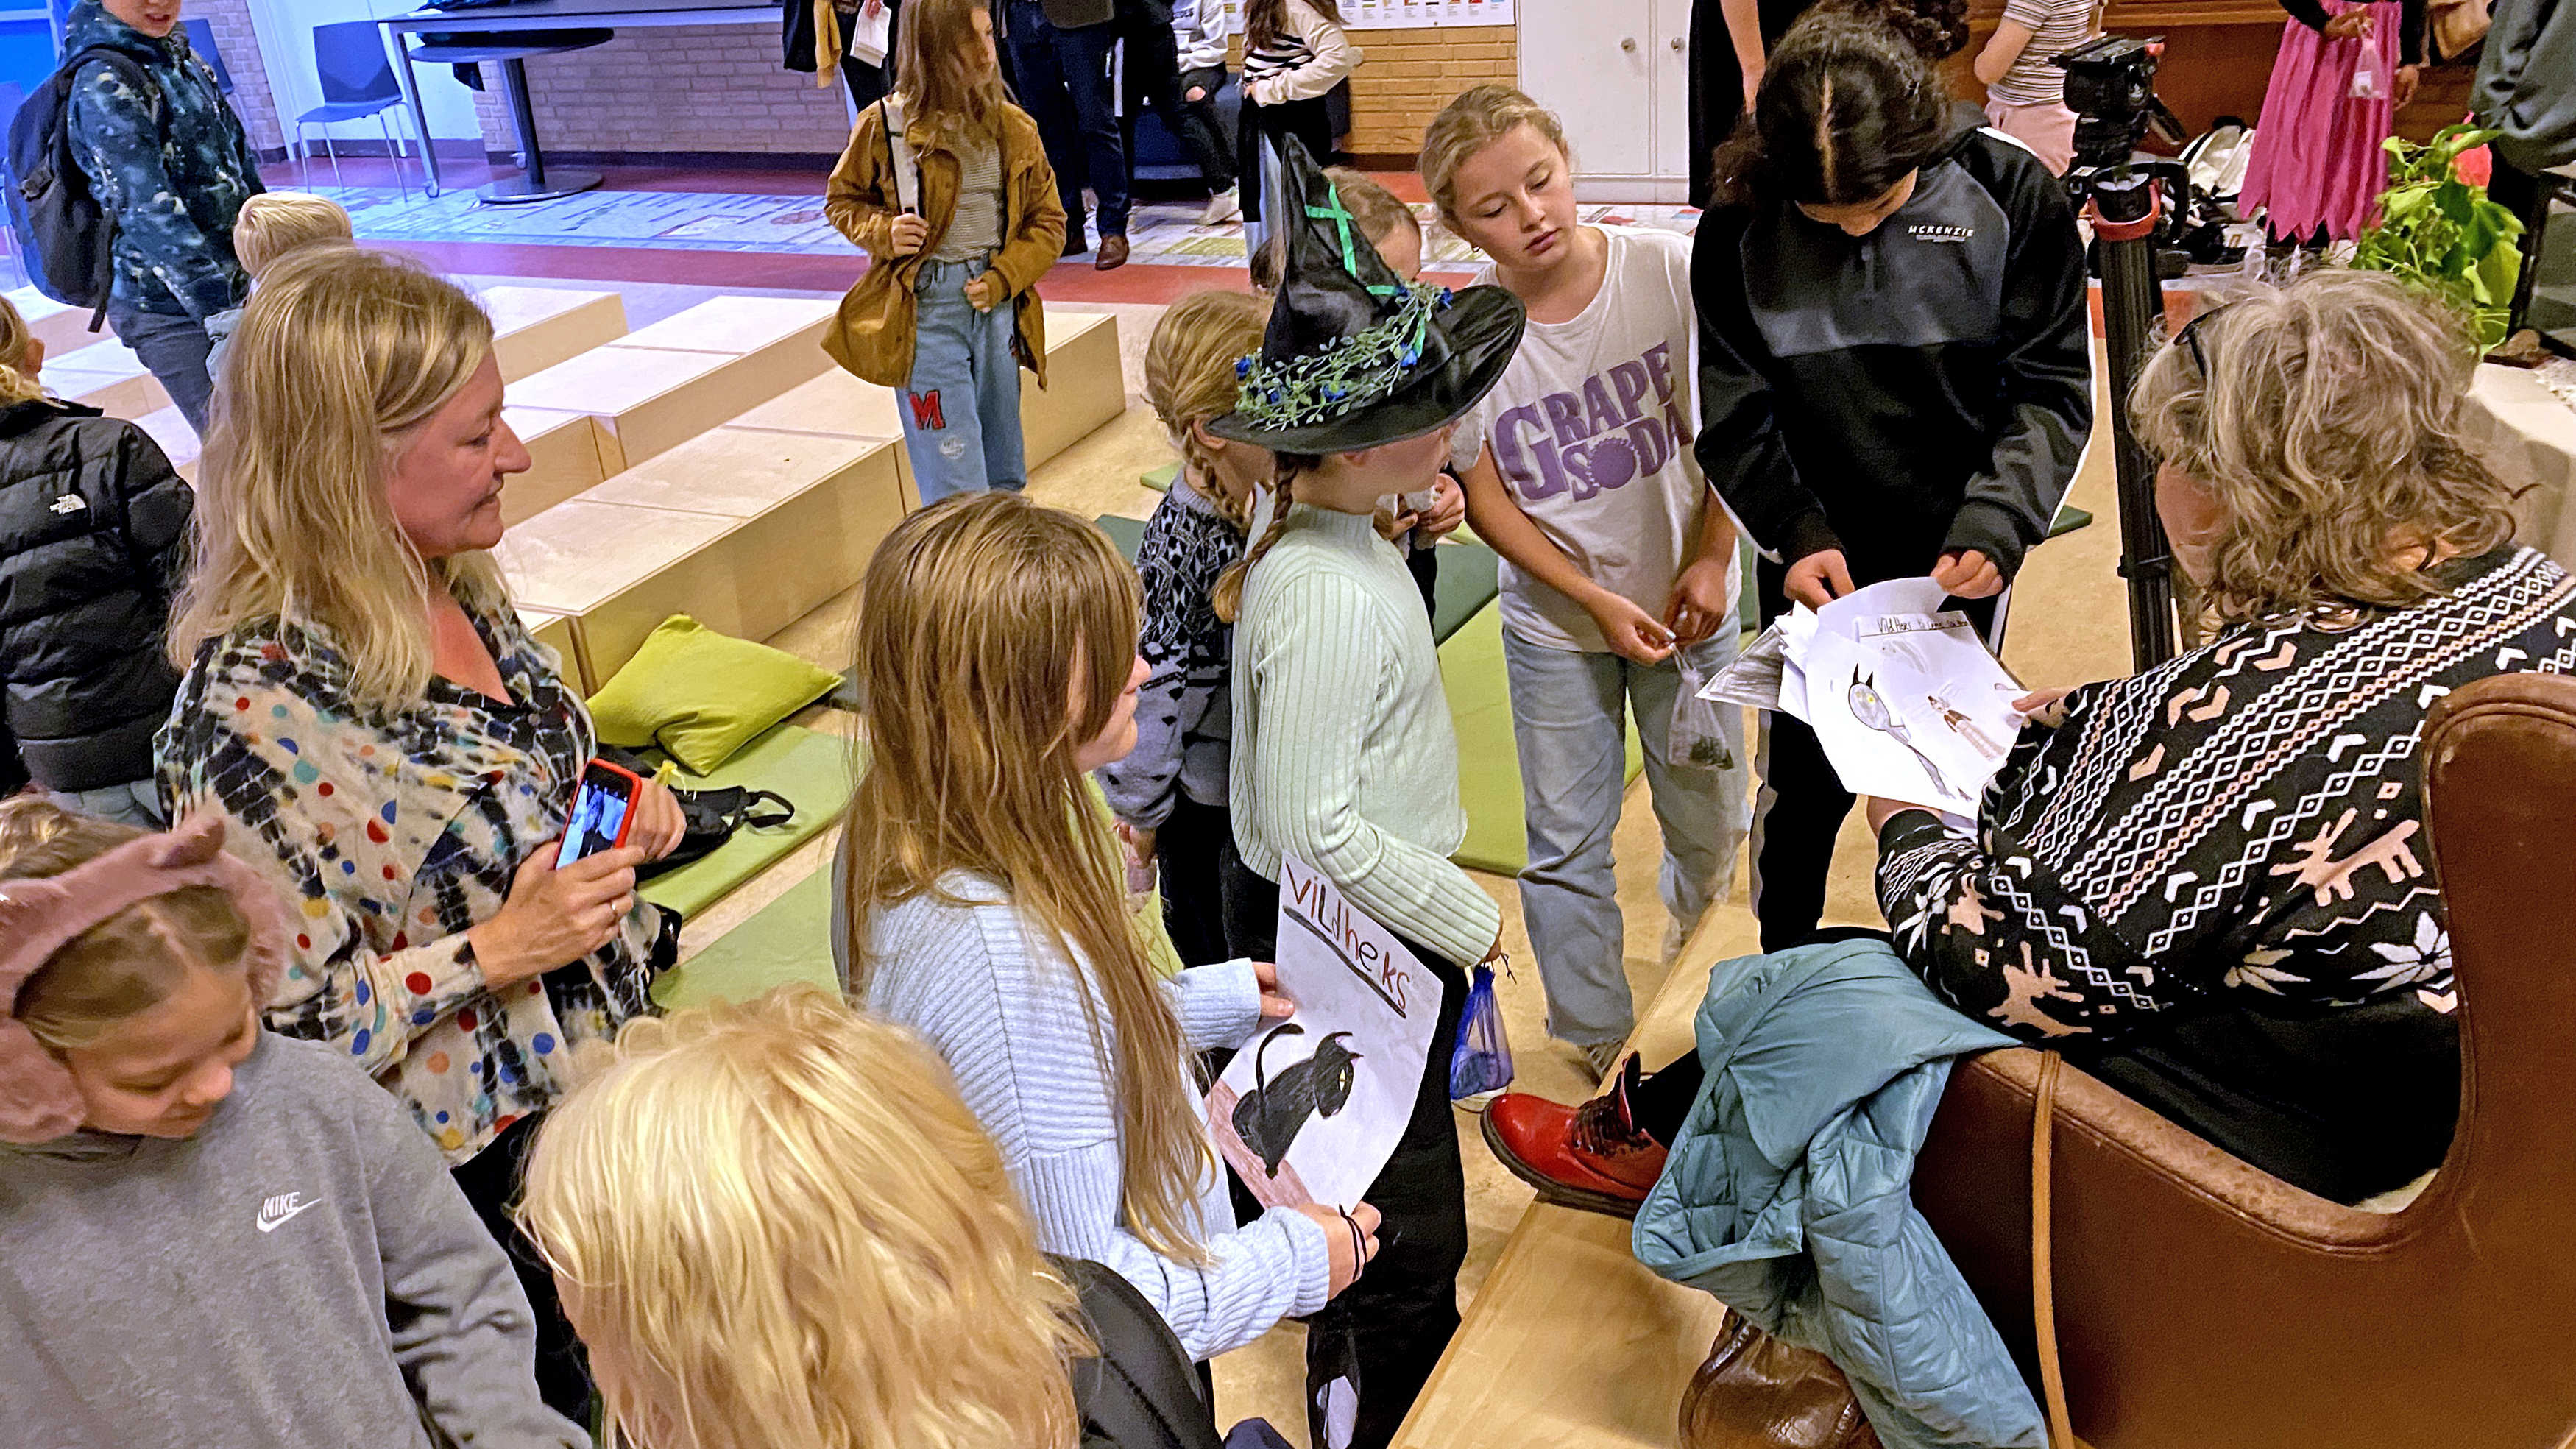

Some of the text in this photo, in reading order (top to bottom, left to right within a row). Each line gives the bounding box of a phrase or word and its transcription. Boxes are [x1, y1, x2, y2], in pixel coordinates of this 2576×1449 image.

[908, 389, 946, 430] M
[1495, 341, 1674, 500] GRAPE
[263, 1191, 301, 1219] NIKE
